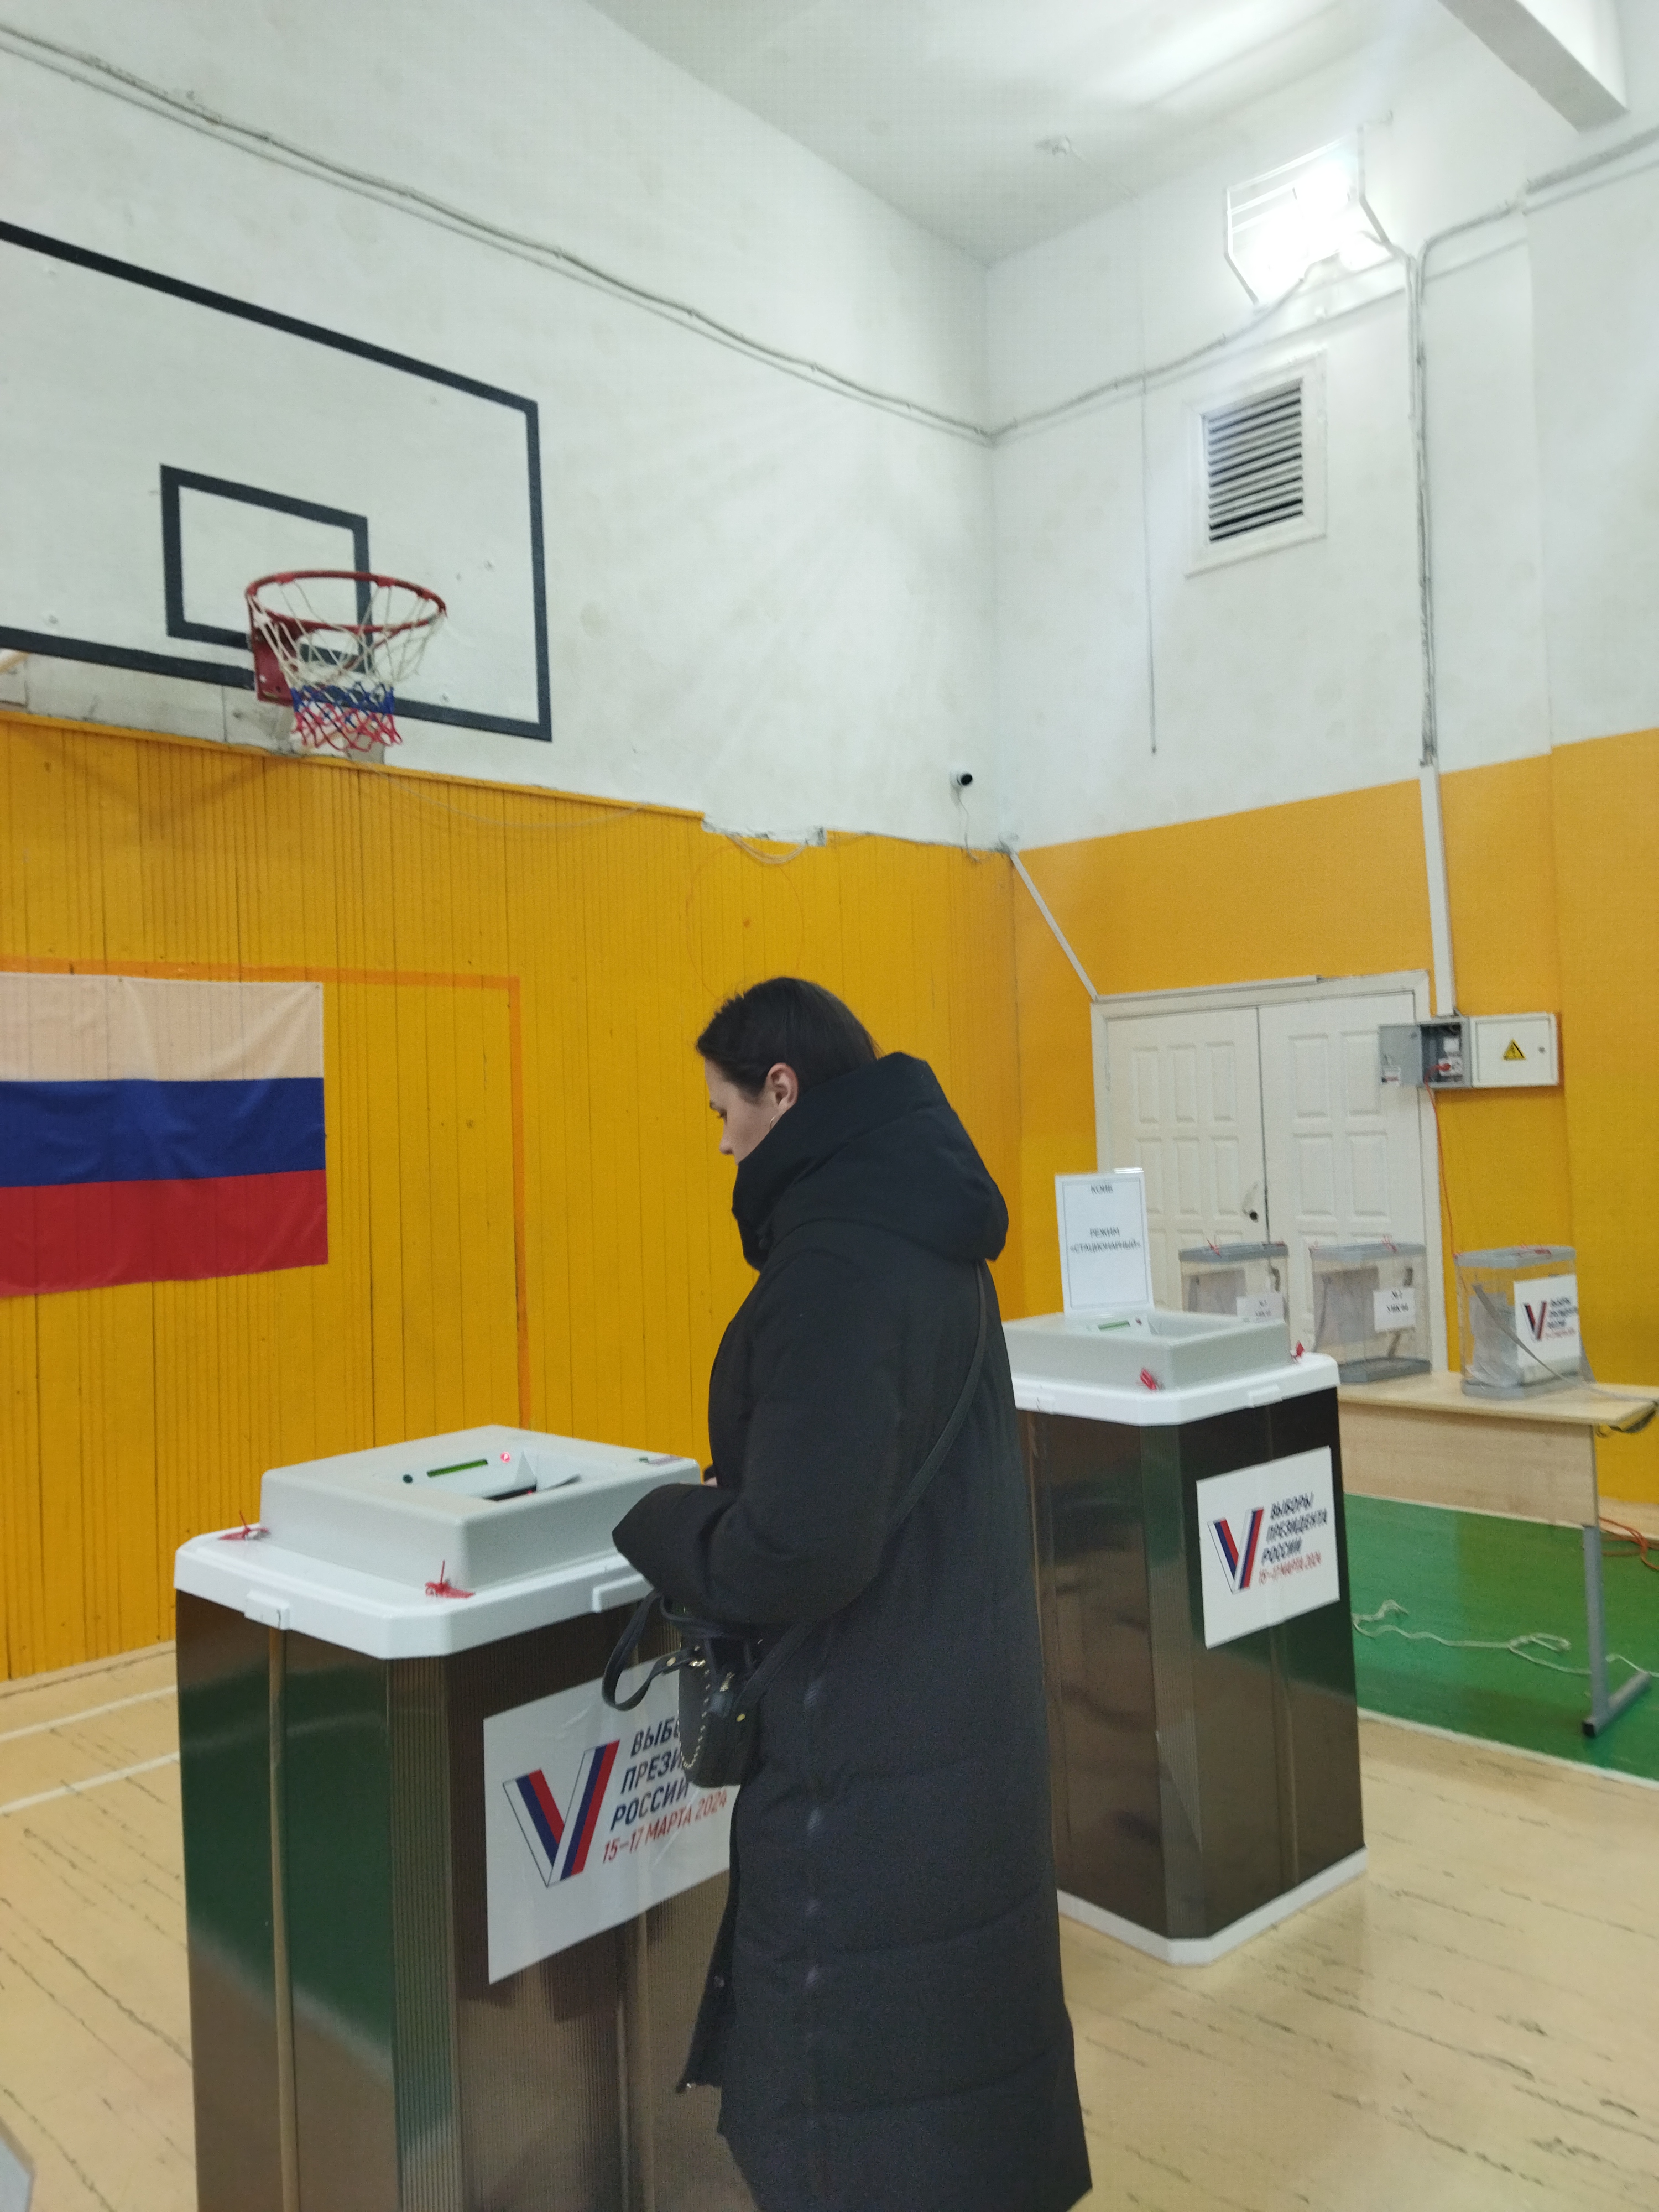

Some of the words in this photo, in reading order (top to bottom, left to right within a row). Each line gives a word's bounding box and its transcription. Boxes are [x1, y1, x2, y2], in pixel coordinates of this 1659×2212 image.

[1270, 1491, 1314, 1521] ВЫБОРЫ
[1261, 1536, 1302, 1566] РОССИИ
[609, 1776, 690, 1832] РОССИИ
[645, 1805, 692, 1845] МАРТА
[694, 1790, 727, 1822] 2024
